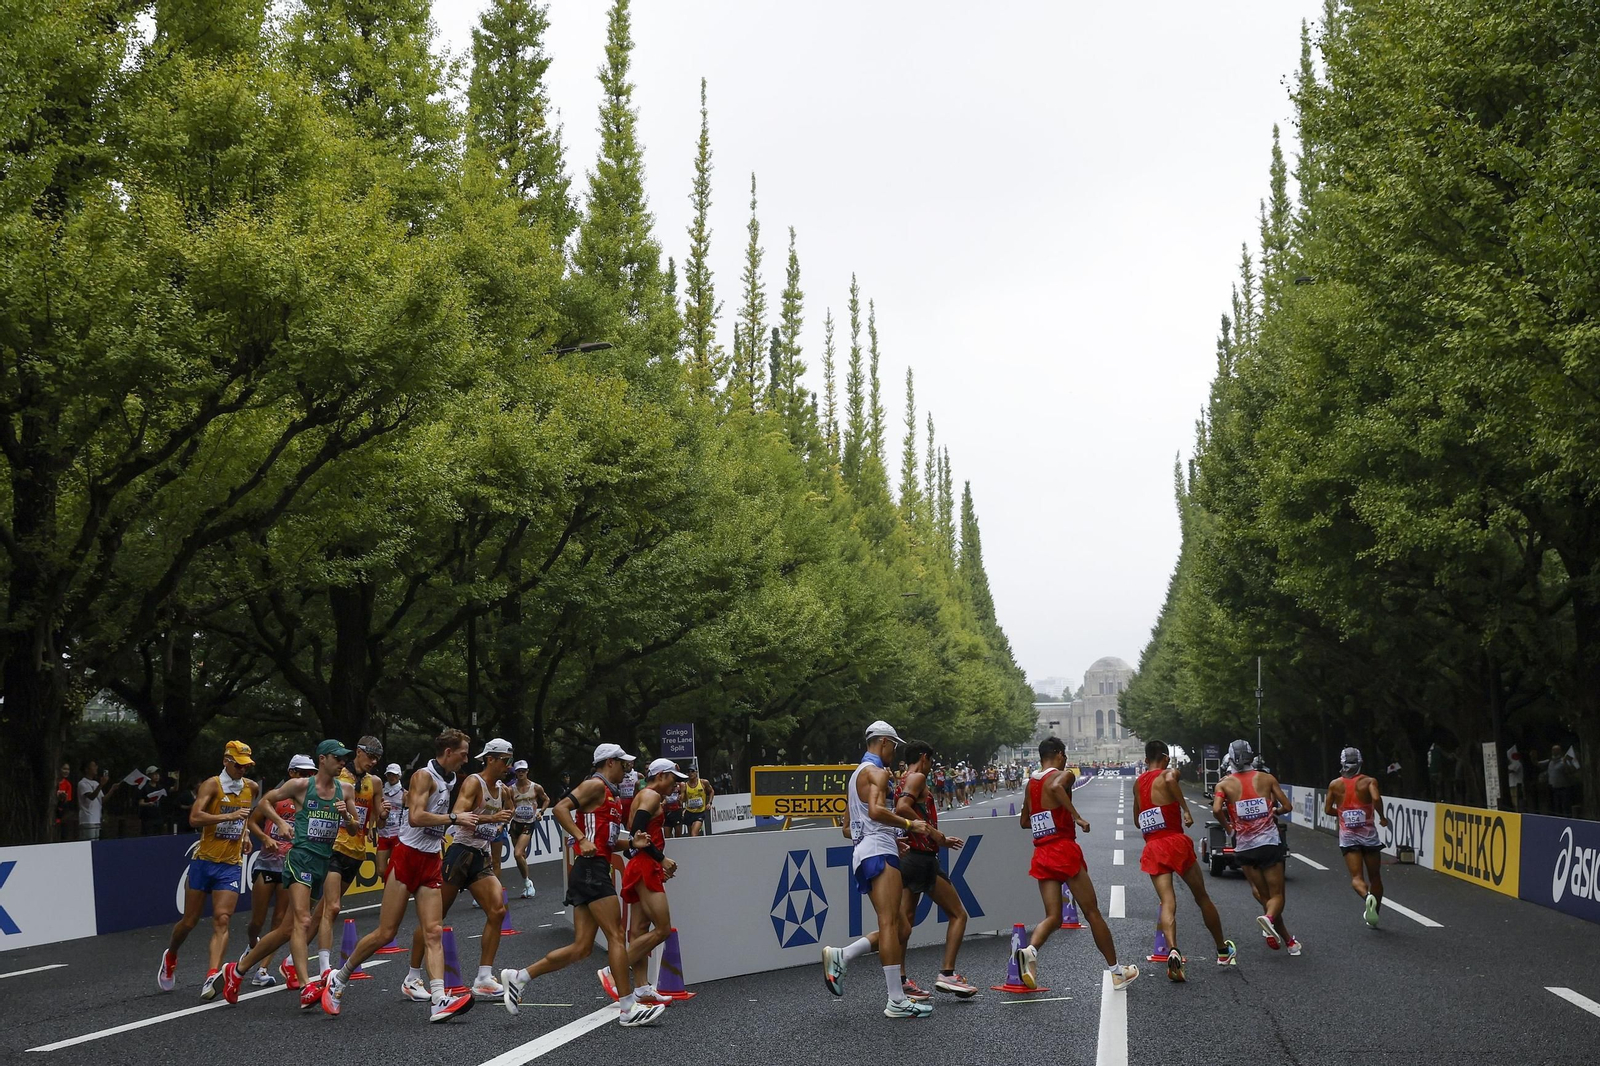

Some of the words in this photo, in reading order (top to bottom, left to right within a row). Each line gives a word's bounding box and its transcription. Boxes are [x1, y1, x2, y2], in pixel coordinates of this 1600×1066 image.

[774, 797, 848, 813] SEIKO
[1245, 799, 1264, 807] TDK
[1142, 809, 1159, 818] TDK
[1244, 806, 1260, 815] 355
[1032, 812, 1049, 822] TDK
[1142, 817, 1156, 827] 313
[319, 820, 338, 829] TDK
[1033, 822, 1047, 831] 311
[1385, 802, 1428, 857] SONY
[308, 827, 332, 837] COWLEY
[1442, 808, 1506, 886] SEIKO
[1570, 845, 1600, 903] asic
[826, 834, 985, 938] TK
